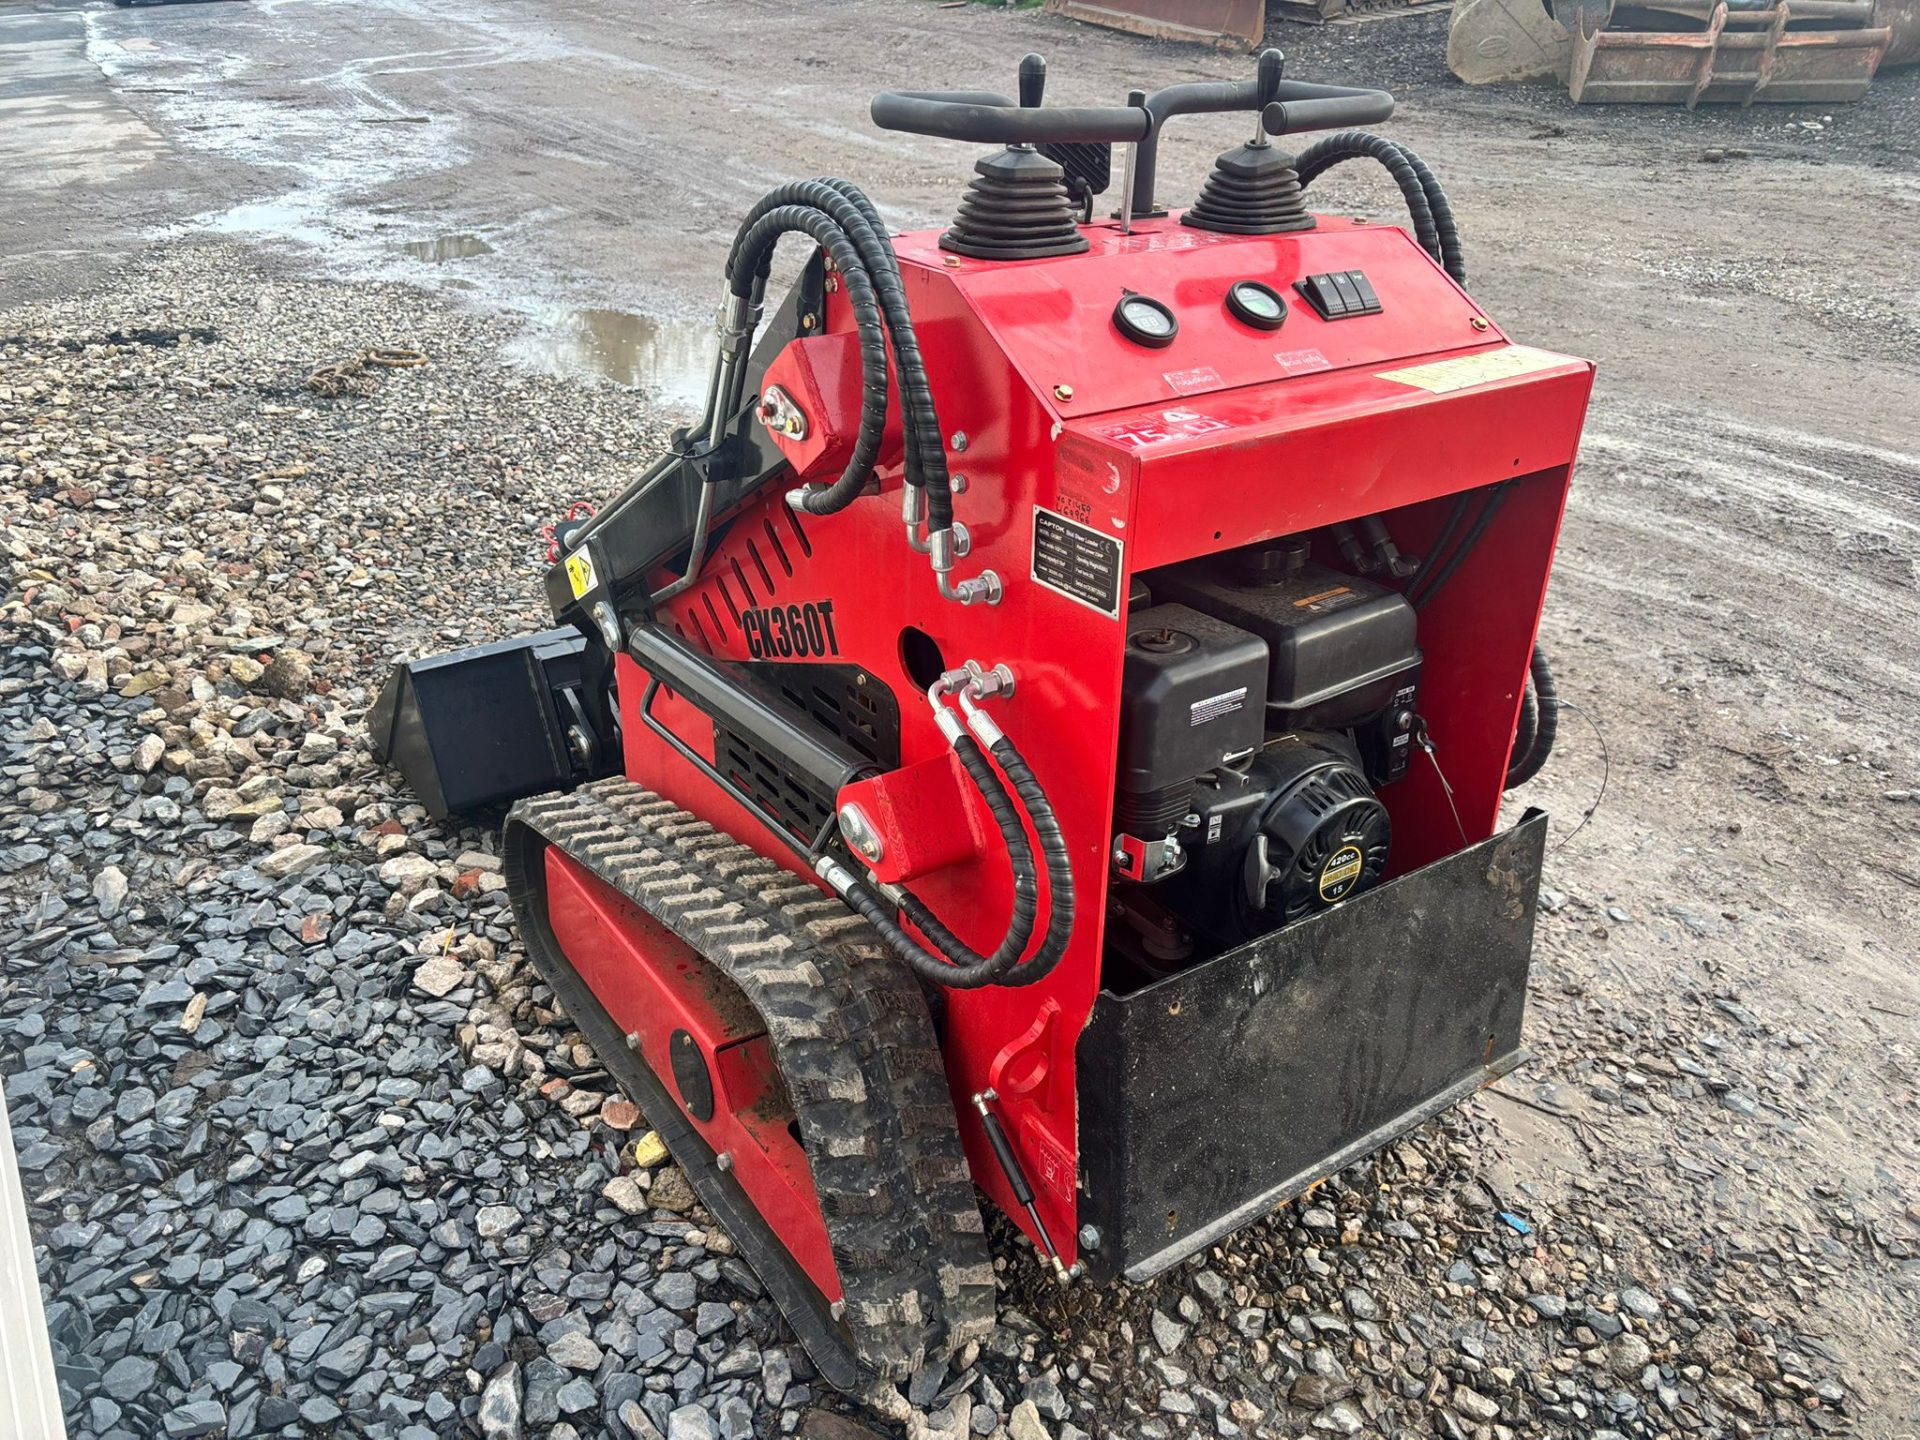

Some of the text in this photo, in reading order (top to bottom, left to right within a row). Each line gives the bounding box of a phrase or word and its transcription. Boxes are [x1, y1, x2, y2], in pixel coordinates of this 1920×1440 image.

[1039, 518, 1065, 533] CAPTOK
[742, 600, 839, 659] CK360T
[1331, 852, 1356, 867] 420cc
[1332, 884, 1344, 895] 15
